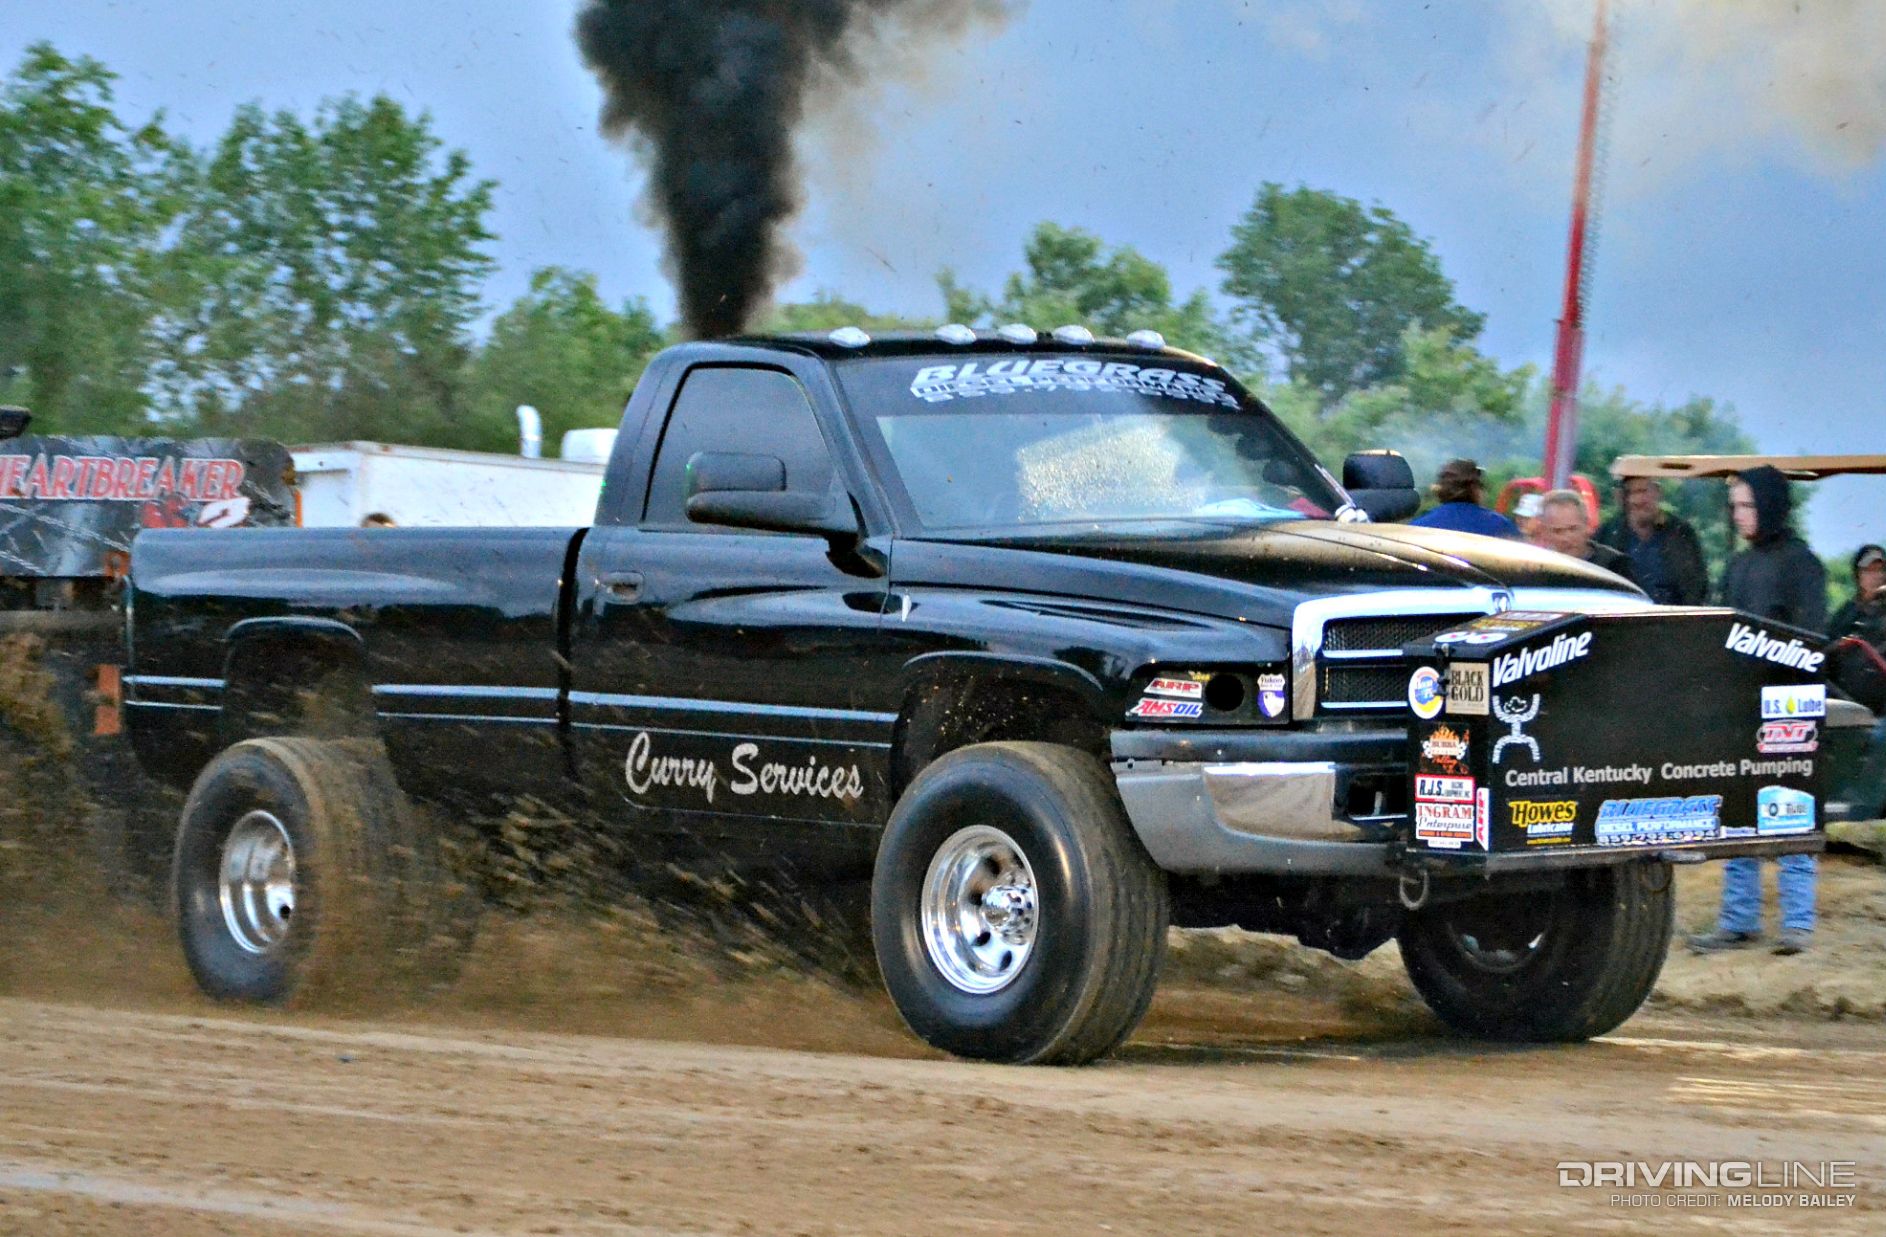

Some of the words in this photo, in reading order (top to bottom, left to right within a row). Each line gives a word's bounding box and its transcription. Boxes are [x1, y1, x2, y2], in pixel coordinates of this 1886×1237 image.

[914, 359, 1226, 392] BLUEGRASS
[1725, 623, 1824, 672] Valvoline
[1493, 632, 1592, 687] Valvoline
[1151, 680, 1200, 691] ARP
[1451, 671, 1483, 686] BLACK
[1451, 686, 1483, 701] GOLD
[1137, 700, 1201, 716] AMSOIL
[1764, 699, 1782, 714] U.S.
[1797, 698, 1822, 713] Lube
[625, 732, 717, 803] Curry
[731, 743, 863, 799] Services
[1505, 765, 1568, 787] Central
[1573, 764, 1653, 784] Kentucky
[1661, 760, 1736, 780] Concrete
[1740, 757, 1813, 778] Pumping
[1418, 805, 1472, 819] INGRAM
[1511, 801, 1576, 828] Howes
